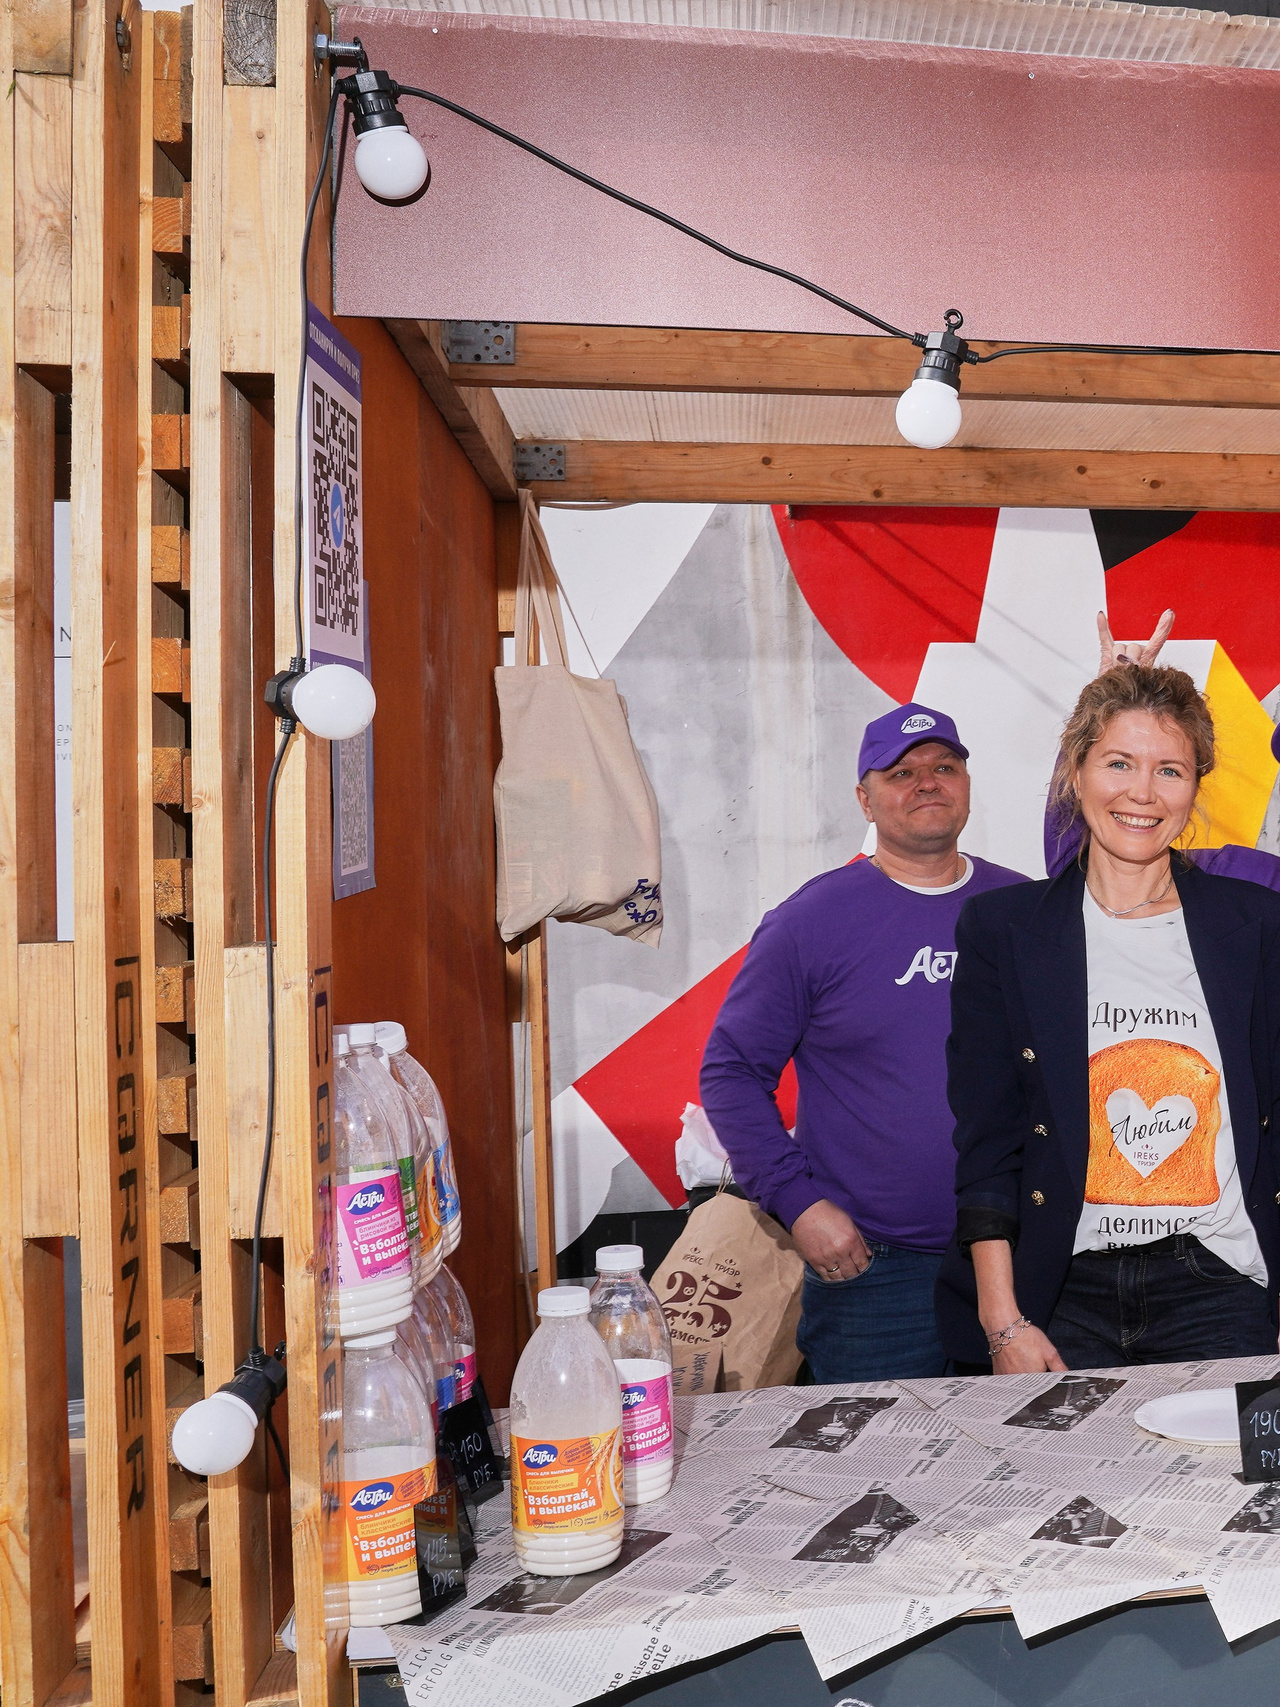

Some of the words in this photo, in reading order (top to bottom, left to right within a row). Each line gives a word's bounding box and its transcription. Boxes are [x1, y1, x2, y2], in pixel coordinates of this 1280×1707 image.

[1092, 1001, 1198, 1034] Дружим
[1108, 1108, 1193, 1158] Любим
[1133, 1151, 1160, 1161] IREKS
[346, 1190, 385, 1211] Астри
[362, 1256, 371, 1266] и
[714, 1262, 741, 1277] ТРИЭР
[661, 1270, 743, 1338] 25
[460, 1431, 483, 1465] 150
[522, 1448, 557, 1465] Астри
[349, 1488, 393, 1506] Астри
[528, 1488, 590, 1505] Взболтай
[529, 1507, 536, 1515] и
[538, 1496, 596, 1515] выпекай
[361, 1553, 371, 1562] и
[415, 1652, 453, 1700] ERFOLG
